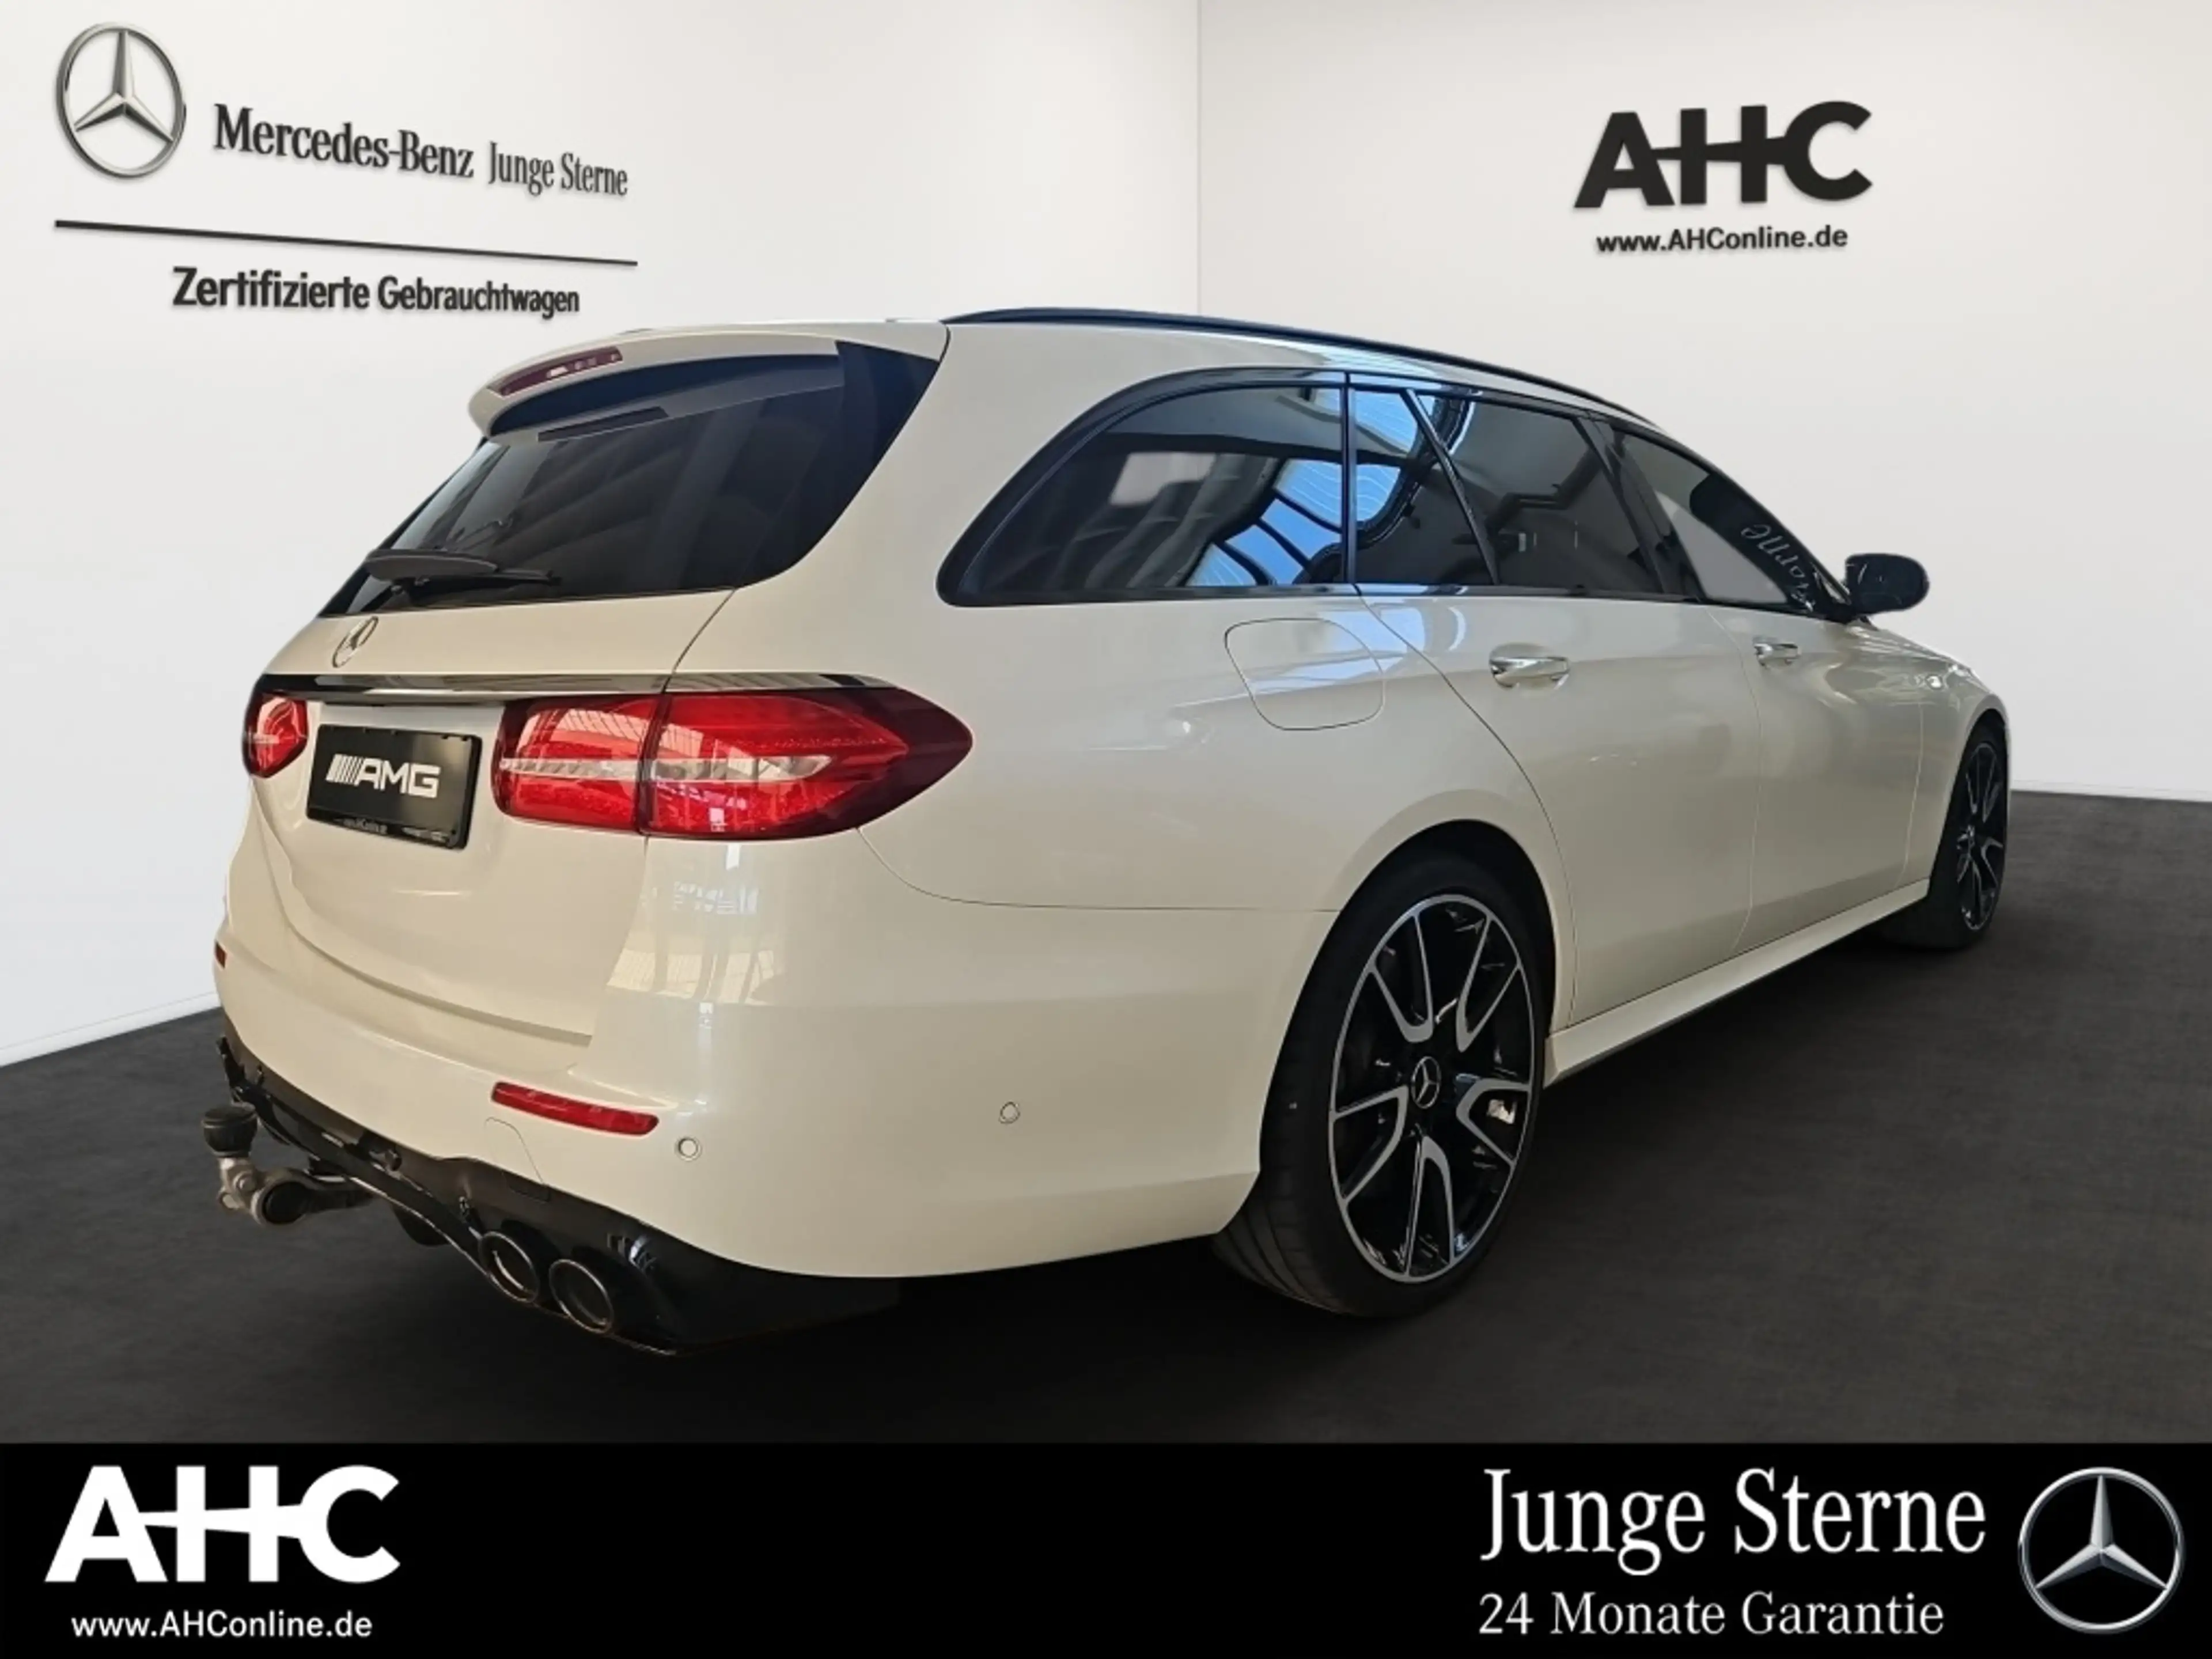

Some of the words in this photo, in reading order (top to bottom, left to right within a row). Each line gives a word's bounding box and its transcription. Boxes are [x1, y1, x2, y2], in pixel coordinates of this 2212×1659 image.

[214, 103, 474, 179] Mercedes-Benz
[488, 142, 555, 196] Junge
[560, 153, 628, 196] Sterne
[1574, 101, 1872, 209] AHC
[1596, 224, 1849, 253] www.AHConline.de
[172, 266, 370, 309] Zertifizierte
[377, 275, 579, 320] Gebrauchtwagen
[353, 756, 441, 798] AMG
